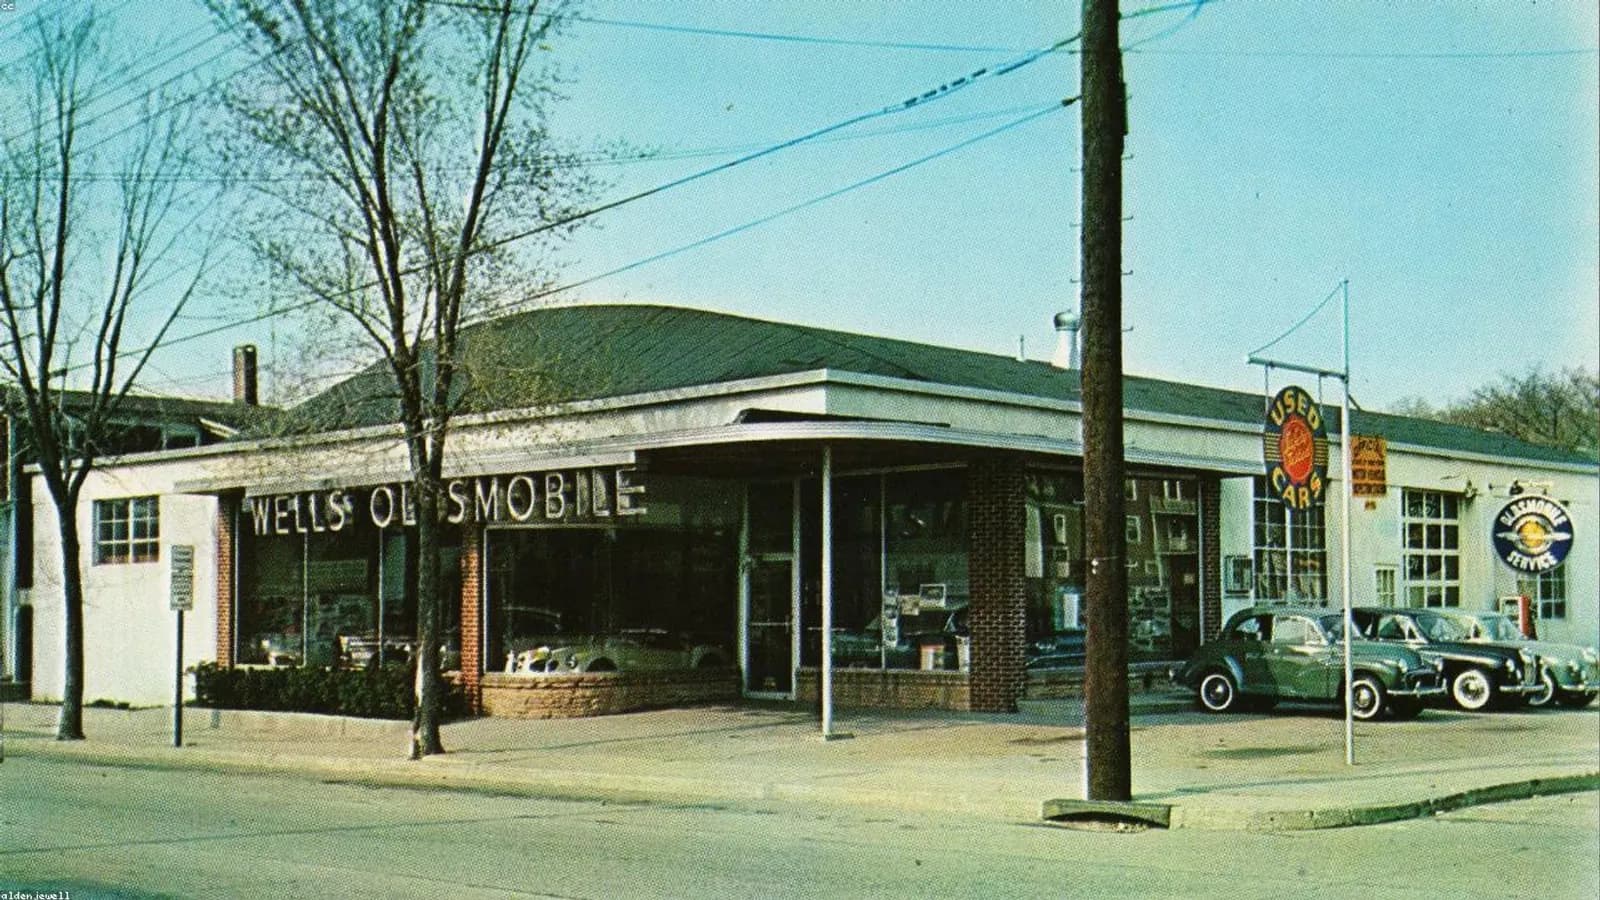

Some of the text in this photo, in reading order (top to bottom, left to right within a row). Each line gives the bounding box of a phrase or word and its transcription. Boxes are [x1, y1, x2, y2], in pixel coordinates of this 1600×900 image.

[1271, 389, 1320, 431] USED
[249, 467, 648, 536] WELLS OLSMOBILE
[1272, 466, 1321, 510] CARS
[1506, 550, 1558, 571] SERVICE
